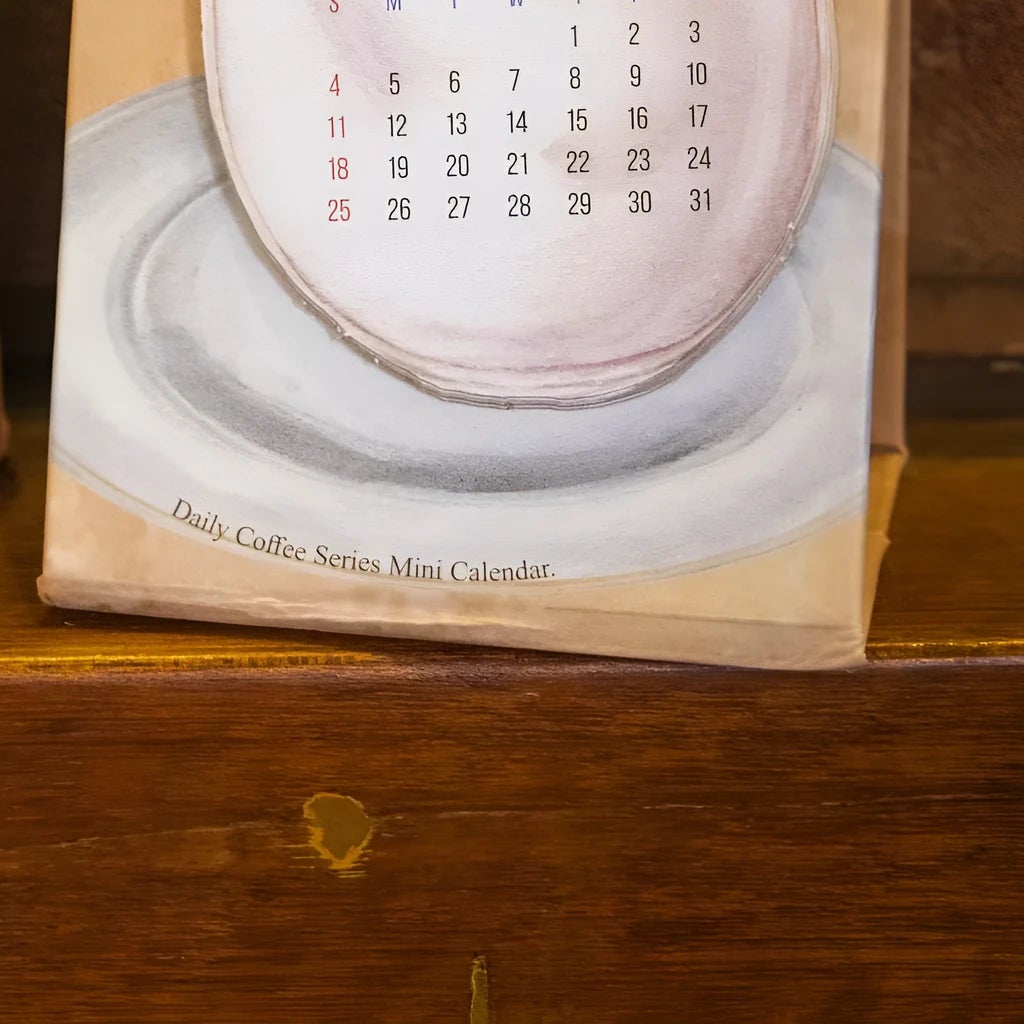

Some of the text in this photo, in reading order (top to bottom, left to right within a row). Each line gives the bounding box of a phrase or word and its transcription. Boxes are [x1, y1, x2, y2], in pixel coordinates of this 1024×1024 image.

[570, 20, 701, 48] 1 2 3
[328, 62, 707, 97] 4 5 6 7 8 9 10
[327, 104, 709, 139] 11 12 13 14 15 16 17
[328, 145, 712, 181] 18 19 20 21 22 23 24
[327, 188, 711, 222] 25 26 27 28 29 30 31
[172, 497, 555, 582] Daily Coffee Series Mini Calendar.
